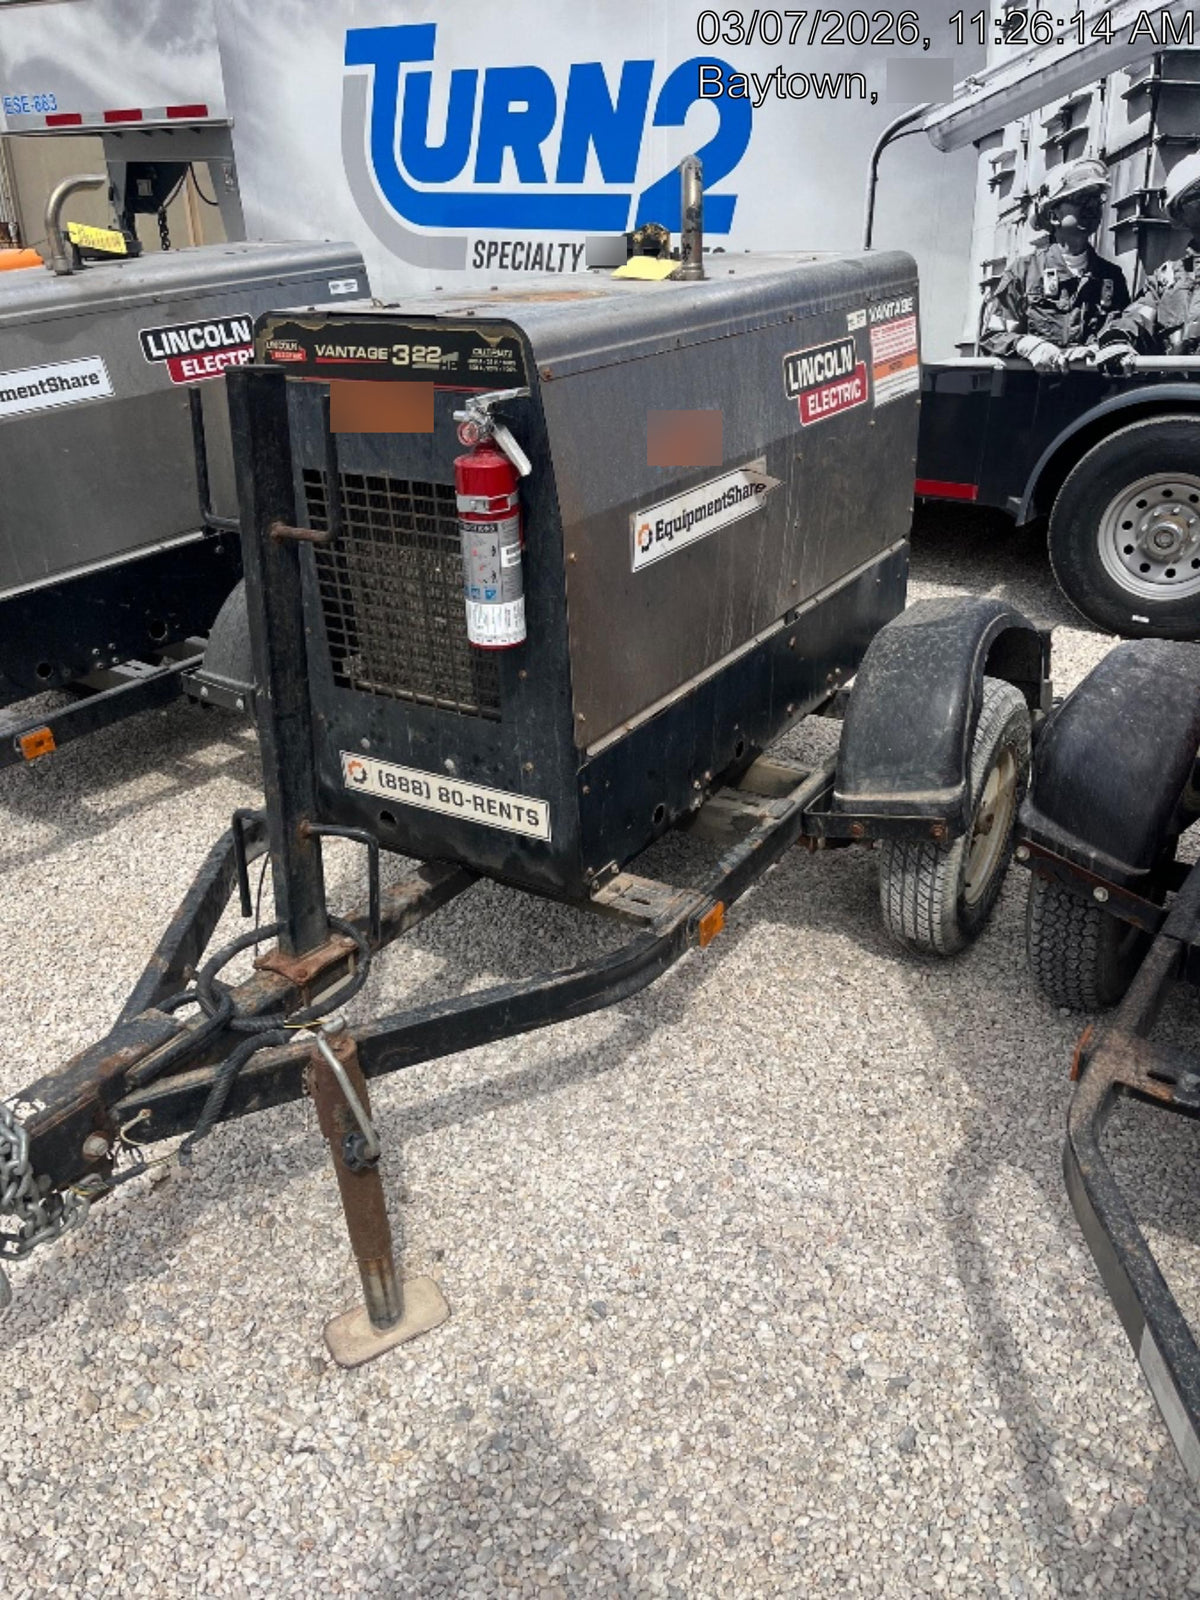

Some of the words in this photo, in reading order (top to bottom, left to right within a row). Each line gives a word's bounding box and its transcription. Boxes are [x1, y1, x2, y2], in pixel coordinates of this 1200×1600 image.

[344, 23, 753, 234] TURN2
[472, 239, 586, 273] SPECIALTY
[146, 319, 252, 358] LINCOLN
[314, 344, 389, 360] VANTAGE
[392, 344, 442, 366] 322
[788, 344, 853, 392] LINCOLN
[806, 378, 862, 417] ELECTRIC
[655, 482, 767, 542] EquipmentShare
[377, 769, 431, 800] (888)
[438, 786, 540, 827] 80-RENTS
